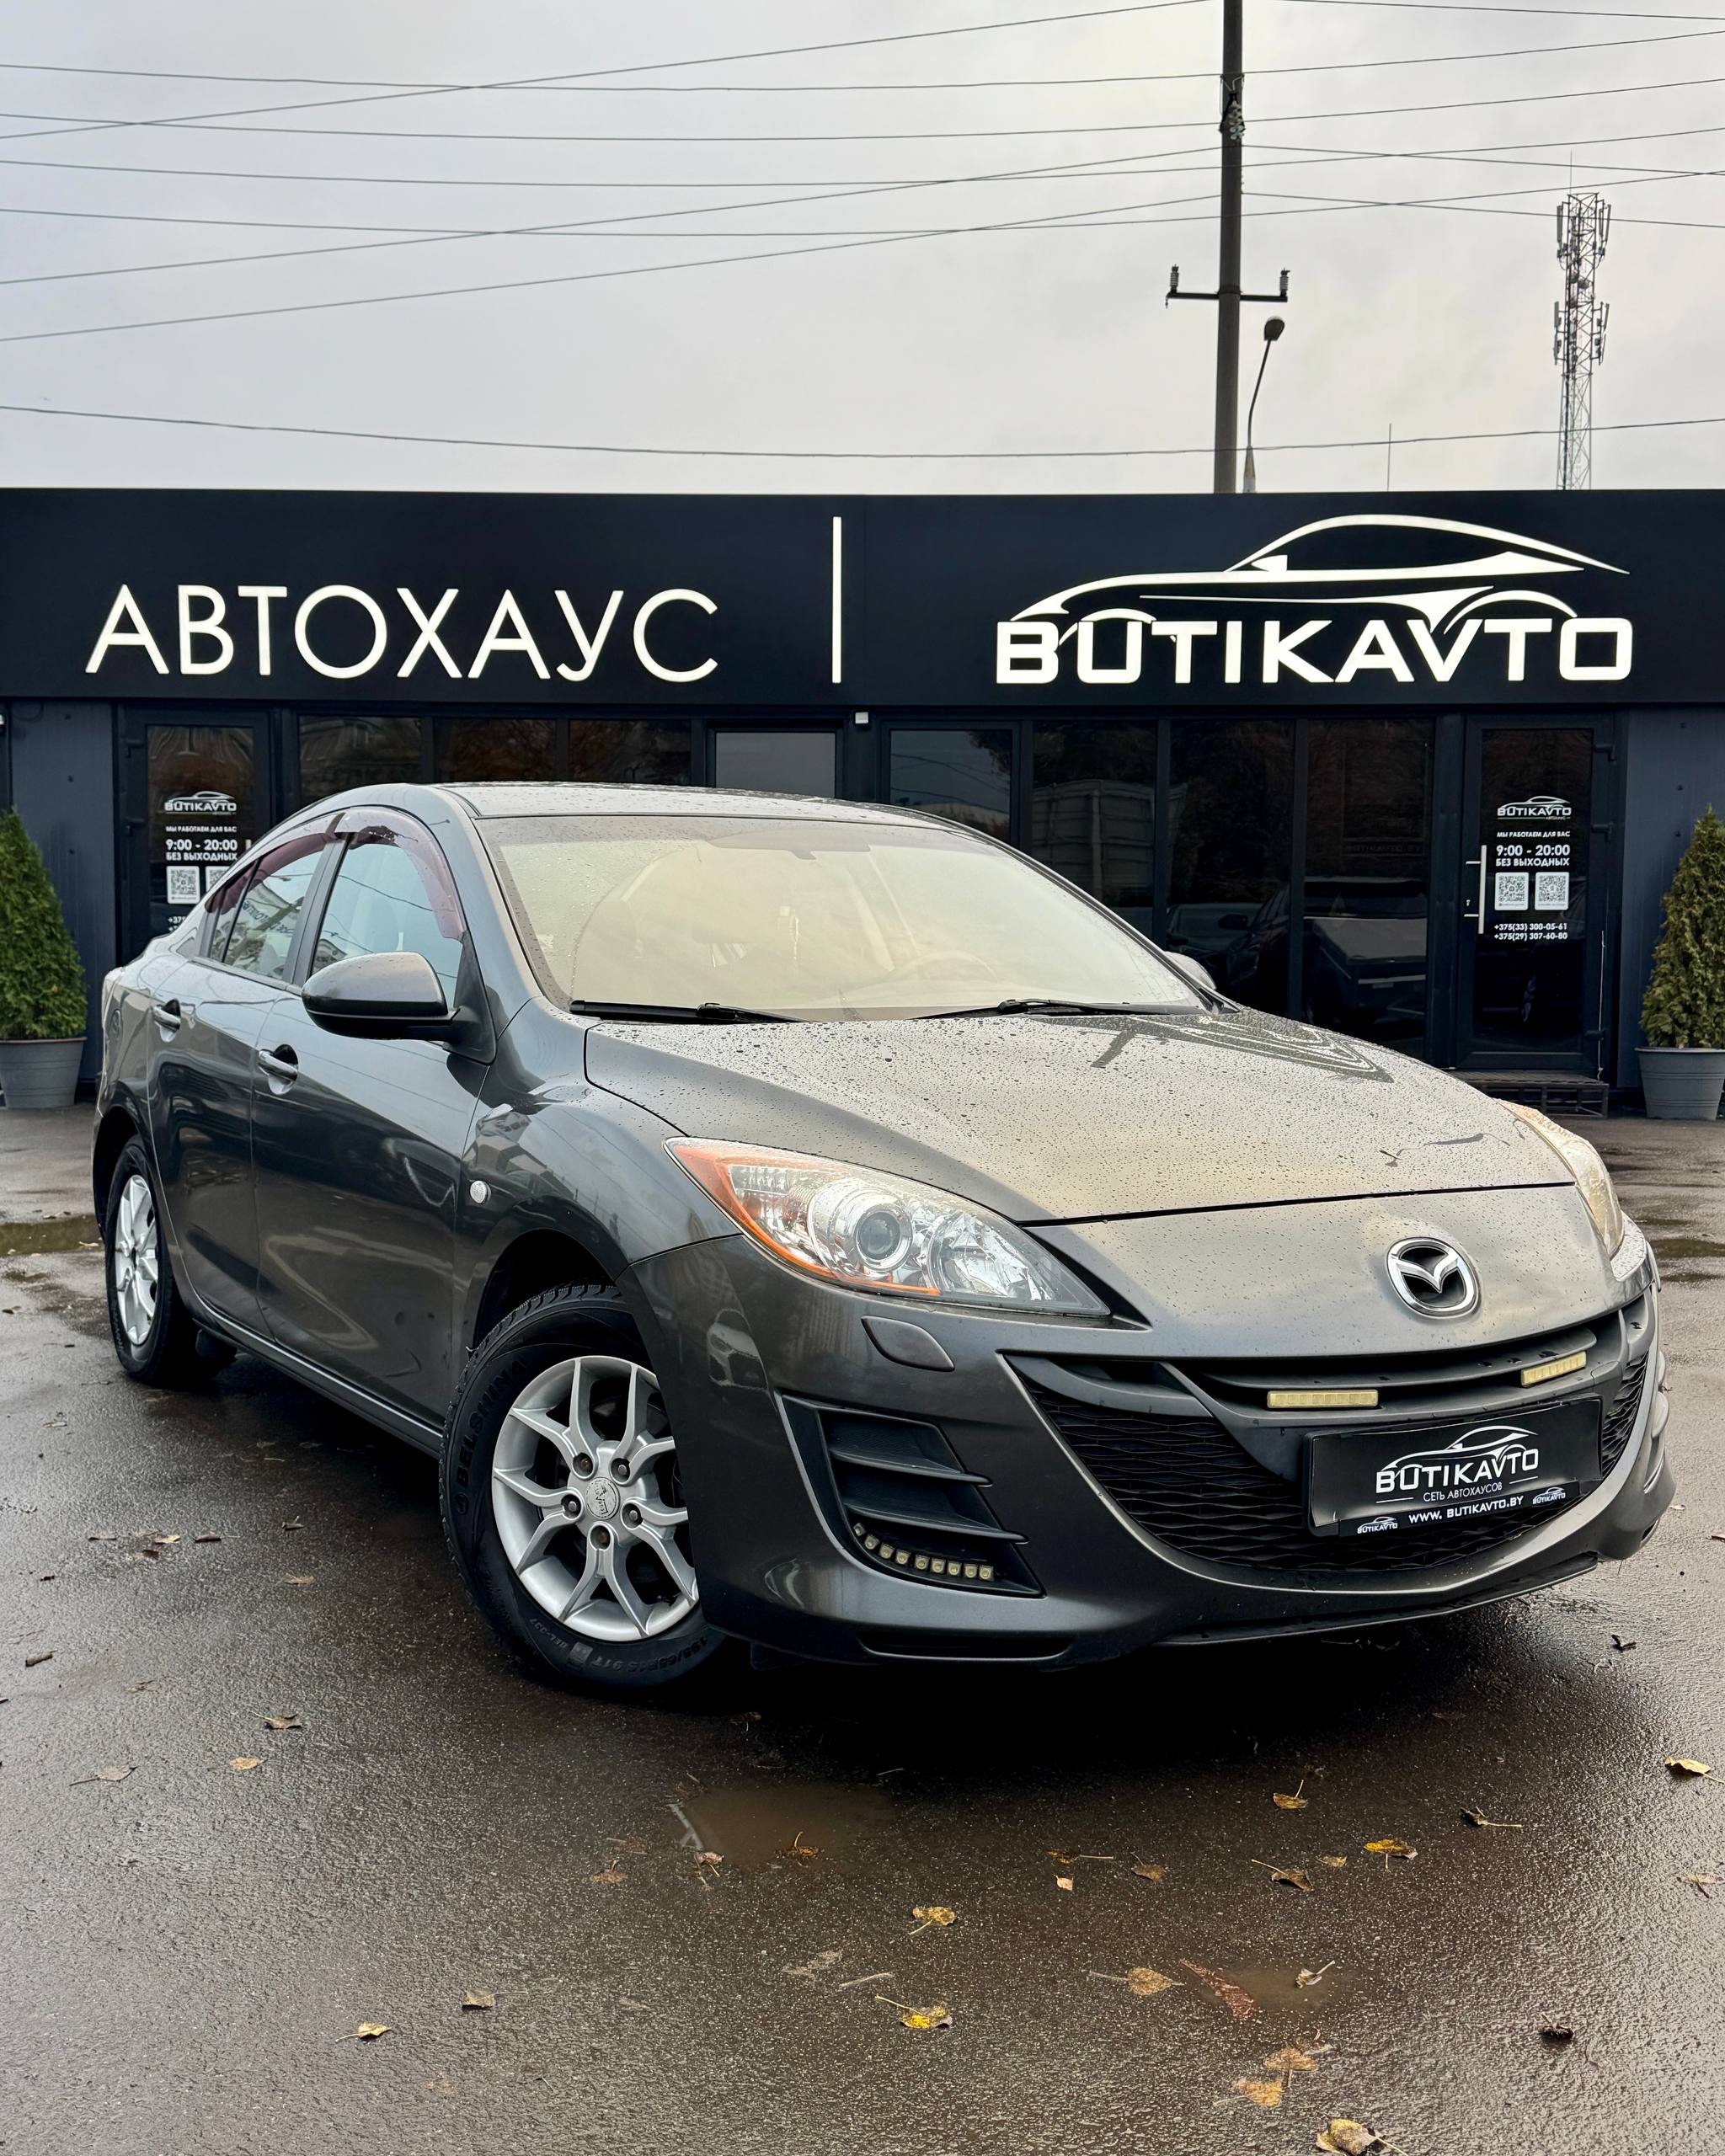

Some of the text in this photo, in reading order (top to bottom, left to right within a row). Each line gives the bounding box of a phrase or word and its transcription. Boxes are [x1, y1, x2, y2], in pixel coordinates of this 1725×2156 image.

[85, 584, 718, 683] АВТОХАУС
[996, 617, 1633, 685] BUTIKAVTO
[164, 803, 238, 812] BUTIKAVTO
[1497, 807, 1572, 816] BUTIKAVTO
[165, 839, 192, 851] 9:00
[204, 839, 238, 851] 20:00
[1496, 845, 1524, 857] 9:00
[1535, 845, 1571, 856] 20:00
[166, 852, 238, 862] БЕЗ ВЫХОДНЫХ
[1495, 857, 1570, 867] БЕЗ ВЫХОДНЫХ
[1494, 923, 1567, 932] +375(33) 300-05-61
[1494, 932, 1528, 942] +375(29)
[1375, 1449, 1539, 1494] BUTIKAVTO
[1423, 1481, 1503, 1502] СЕТЬ АВТОХАУСОВ
[1532, 1492, 1567, 1505] BUTIKAVTO
[1408, 1496, 1525, 1524] WWW. BUTIKAVTO.BY
[1357, 1522, 1398, 1534] BUTIKAVTO
